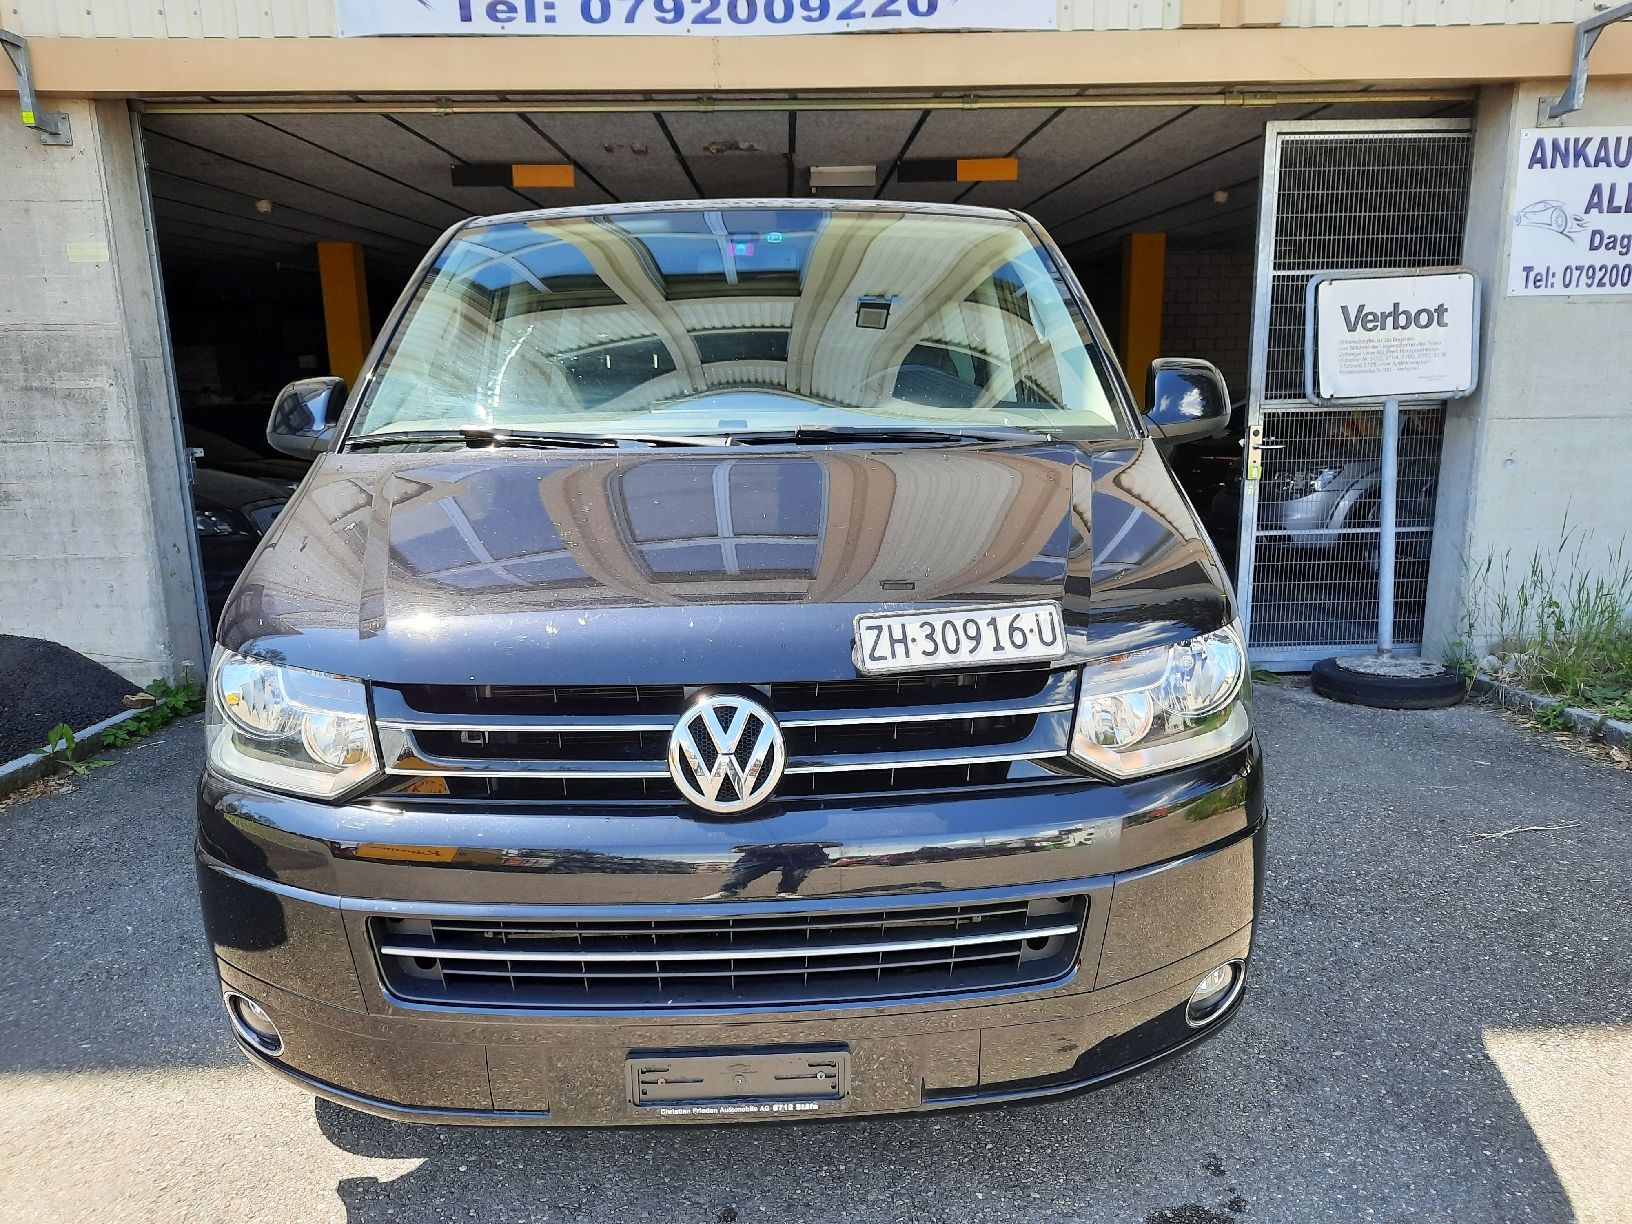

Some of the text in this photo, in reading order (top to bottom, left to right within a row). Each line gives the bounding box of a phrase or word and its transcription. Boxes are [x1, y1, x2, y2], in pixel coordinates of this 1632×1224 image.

[580, 0, 939, 24] 0792009220
[1528, 136, 1632, 169] ANKAU
[1589, 229, 1632, 256] Dag
[1522, 263, 1632, 289] Tel: 079200
[1340, 302, 1449, 332] Verbot
[760, 1104, 770, 1112] AG
